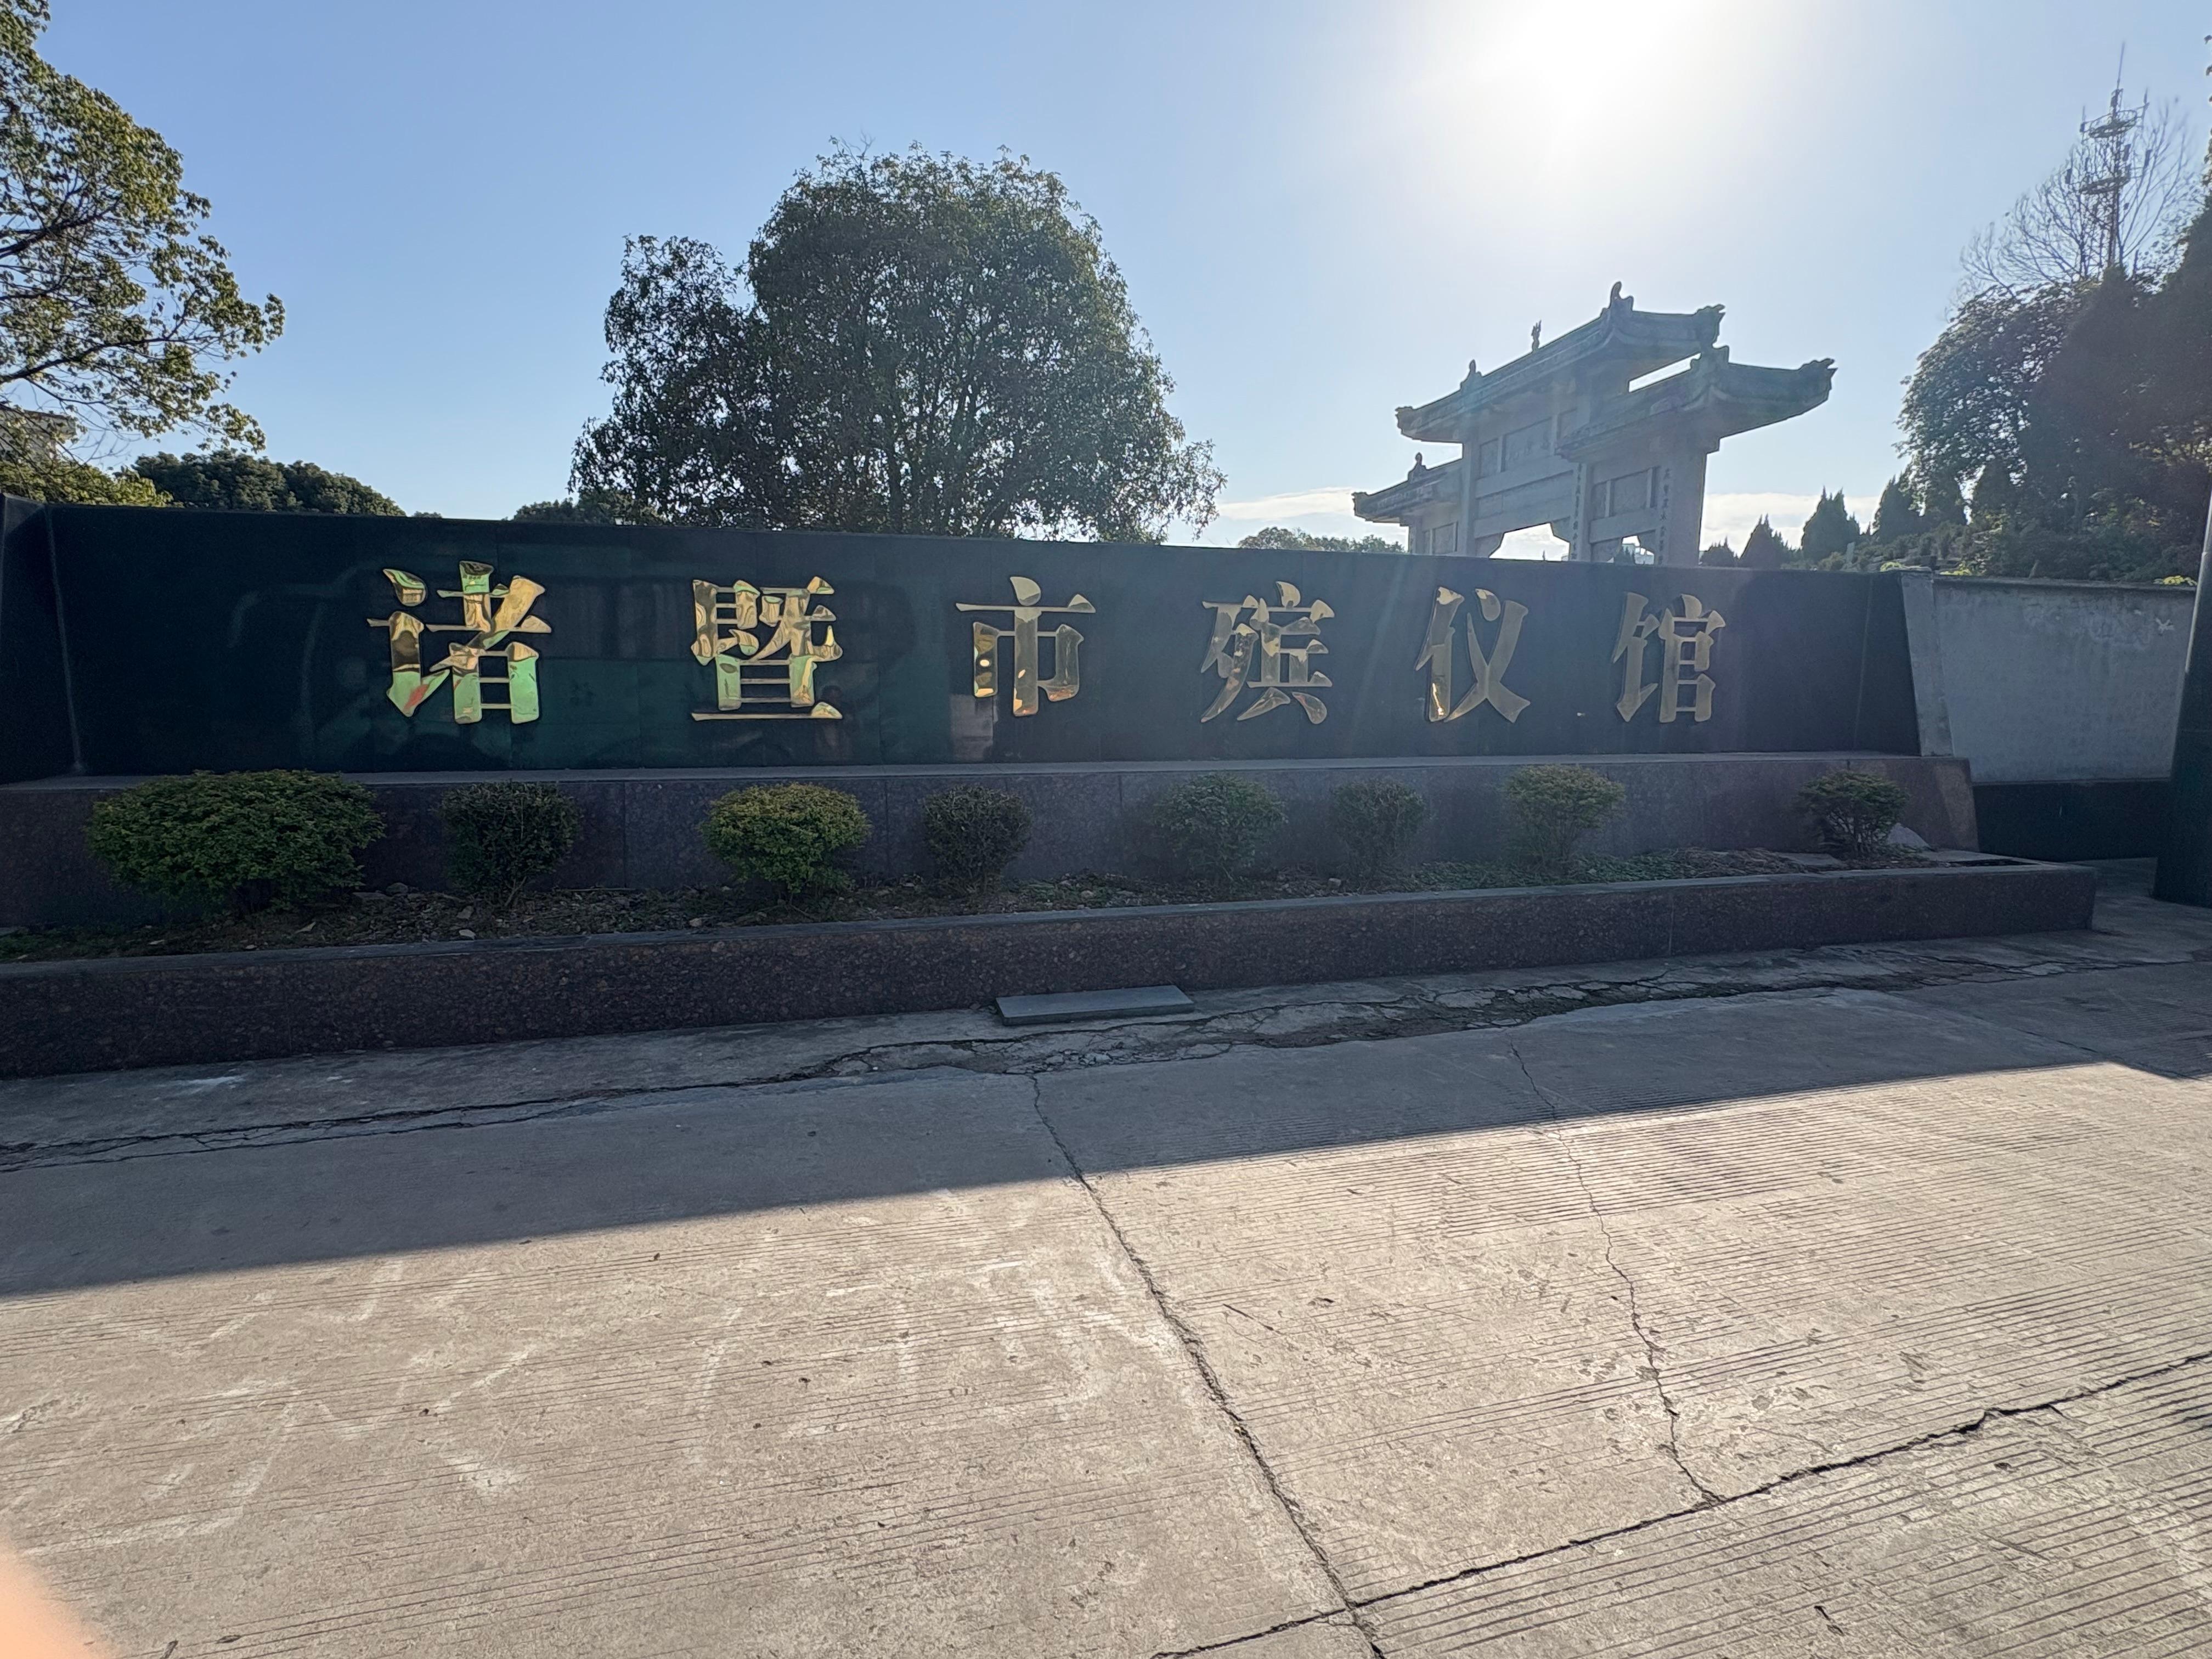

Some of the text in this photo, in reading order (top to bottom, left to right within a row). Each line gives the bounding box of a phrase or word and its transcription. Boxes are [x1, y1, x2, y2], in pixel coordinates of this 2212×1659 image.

[366, 560, 1726, 725] 诸暨市殡仪馆
